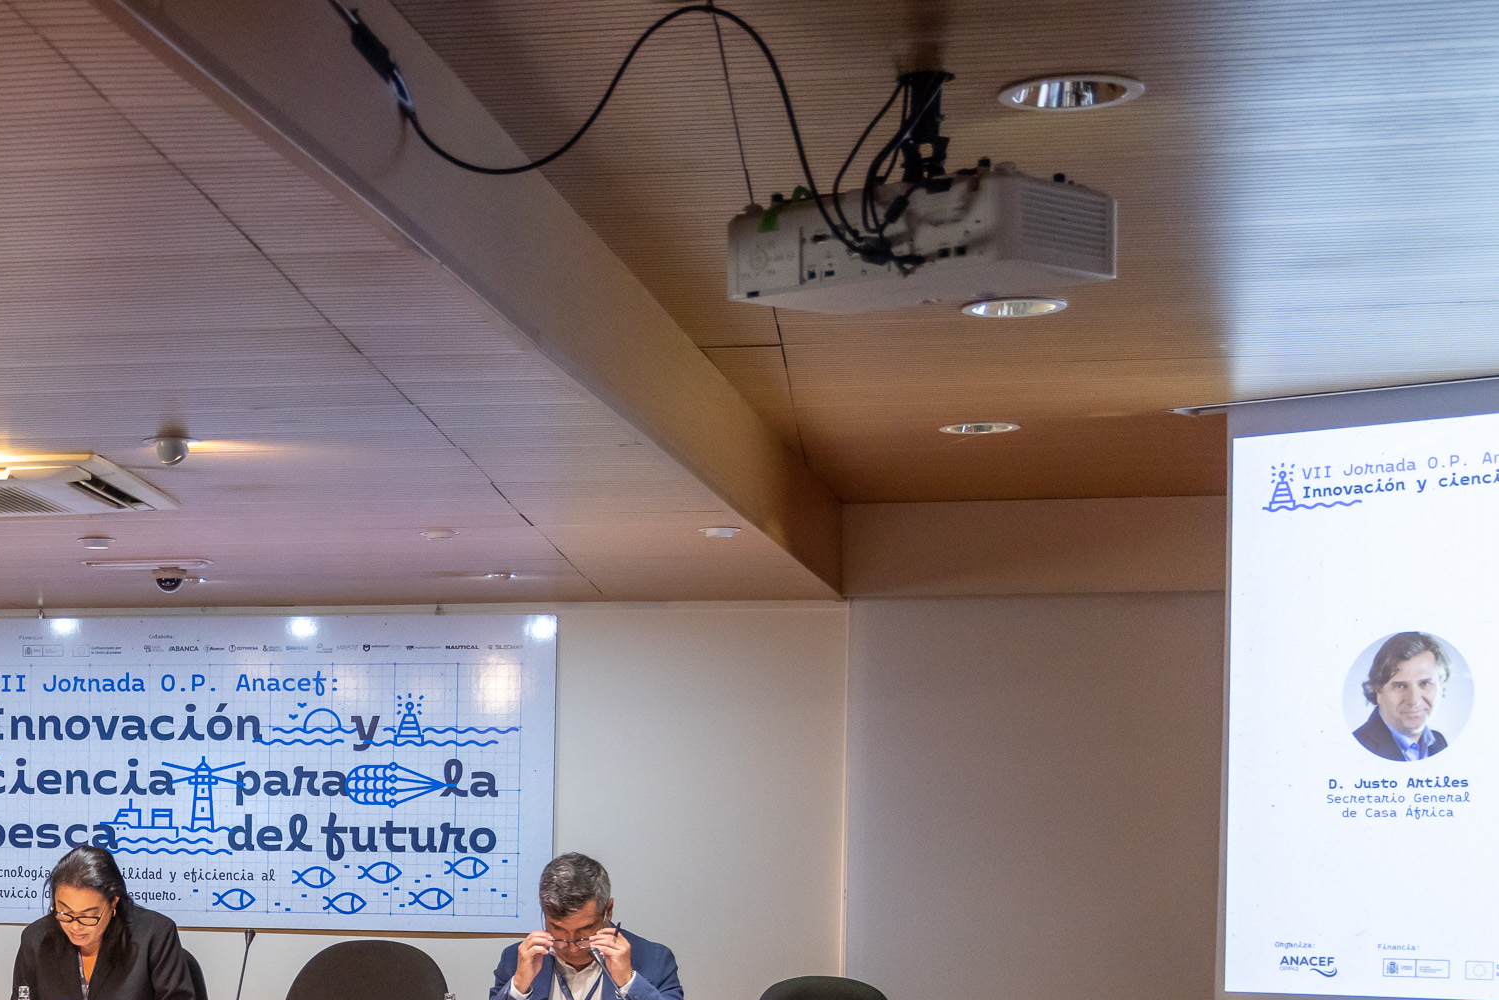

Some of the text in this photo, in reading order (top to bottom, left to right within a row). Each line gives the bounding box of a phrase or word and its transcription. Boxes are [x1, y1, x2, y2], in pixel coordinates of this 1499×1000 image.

[1302, 452, 1499, 480] VII Jornada O.P. An
[1303, 469, 1499, 498] Innovación y cienci
[43, 673, 146, 692] Jornada
[161, 674, 216, 692] O.P.
[236, 670, 338, 696] Anacef:
[351, 716, 380, 751] y
[236, 766, 350, 806] para
[440, 758, 498, 798] la
[1328, 776, 1469, 789] D. Justo Artiles
[1326, 791, 1470, 804] Secretario General
[1342, 804, 1454, 819] de Casa África
[227, 814, 312, 851] del
[321, 812, 497, 861] futuro
[122, 868, 162, 880] ilidad
[170, 870, 177, 882] y
[183, 868, 254, 884] eficiencia
[261, 870, 276, 882] al
[128, 890, 181, 904] esquero.
[1280, 956, 1335, 966] ANACEF
